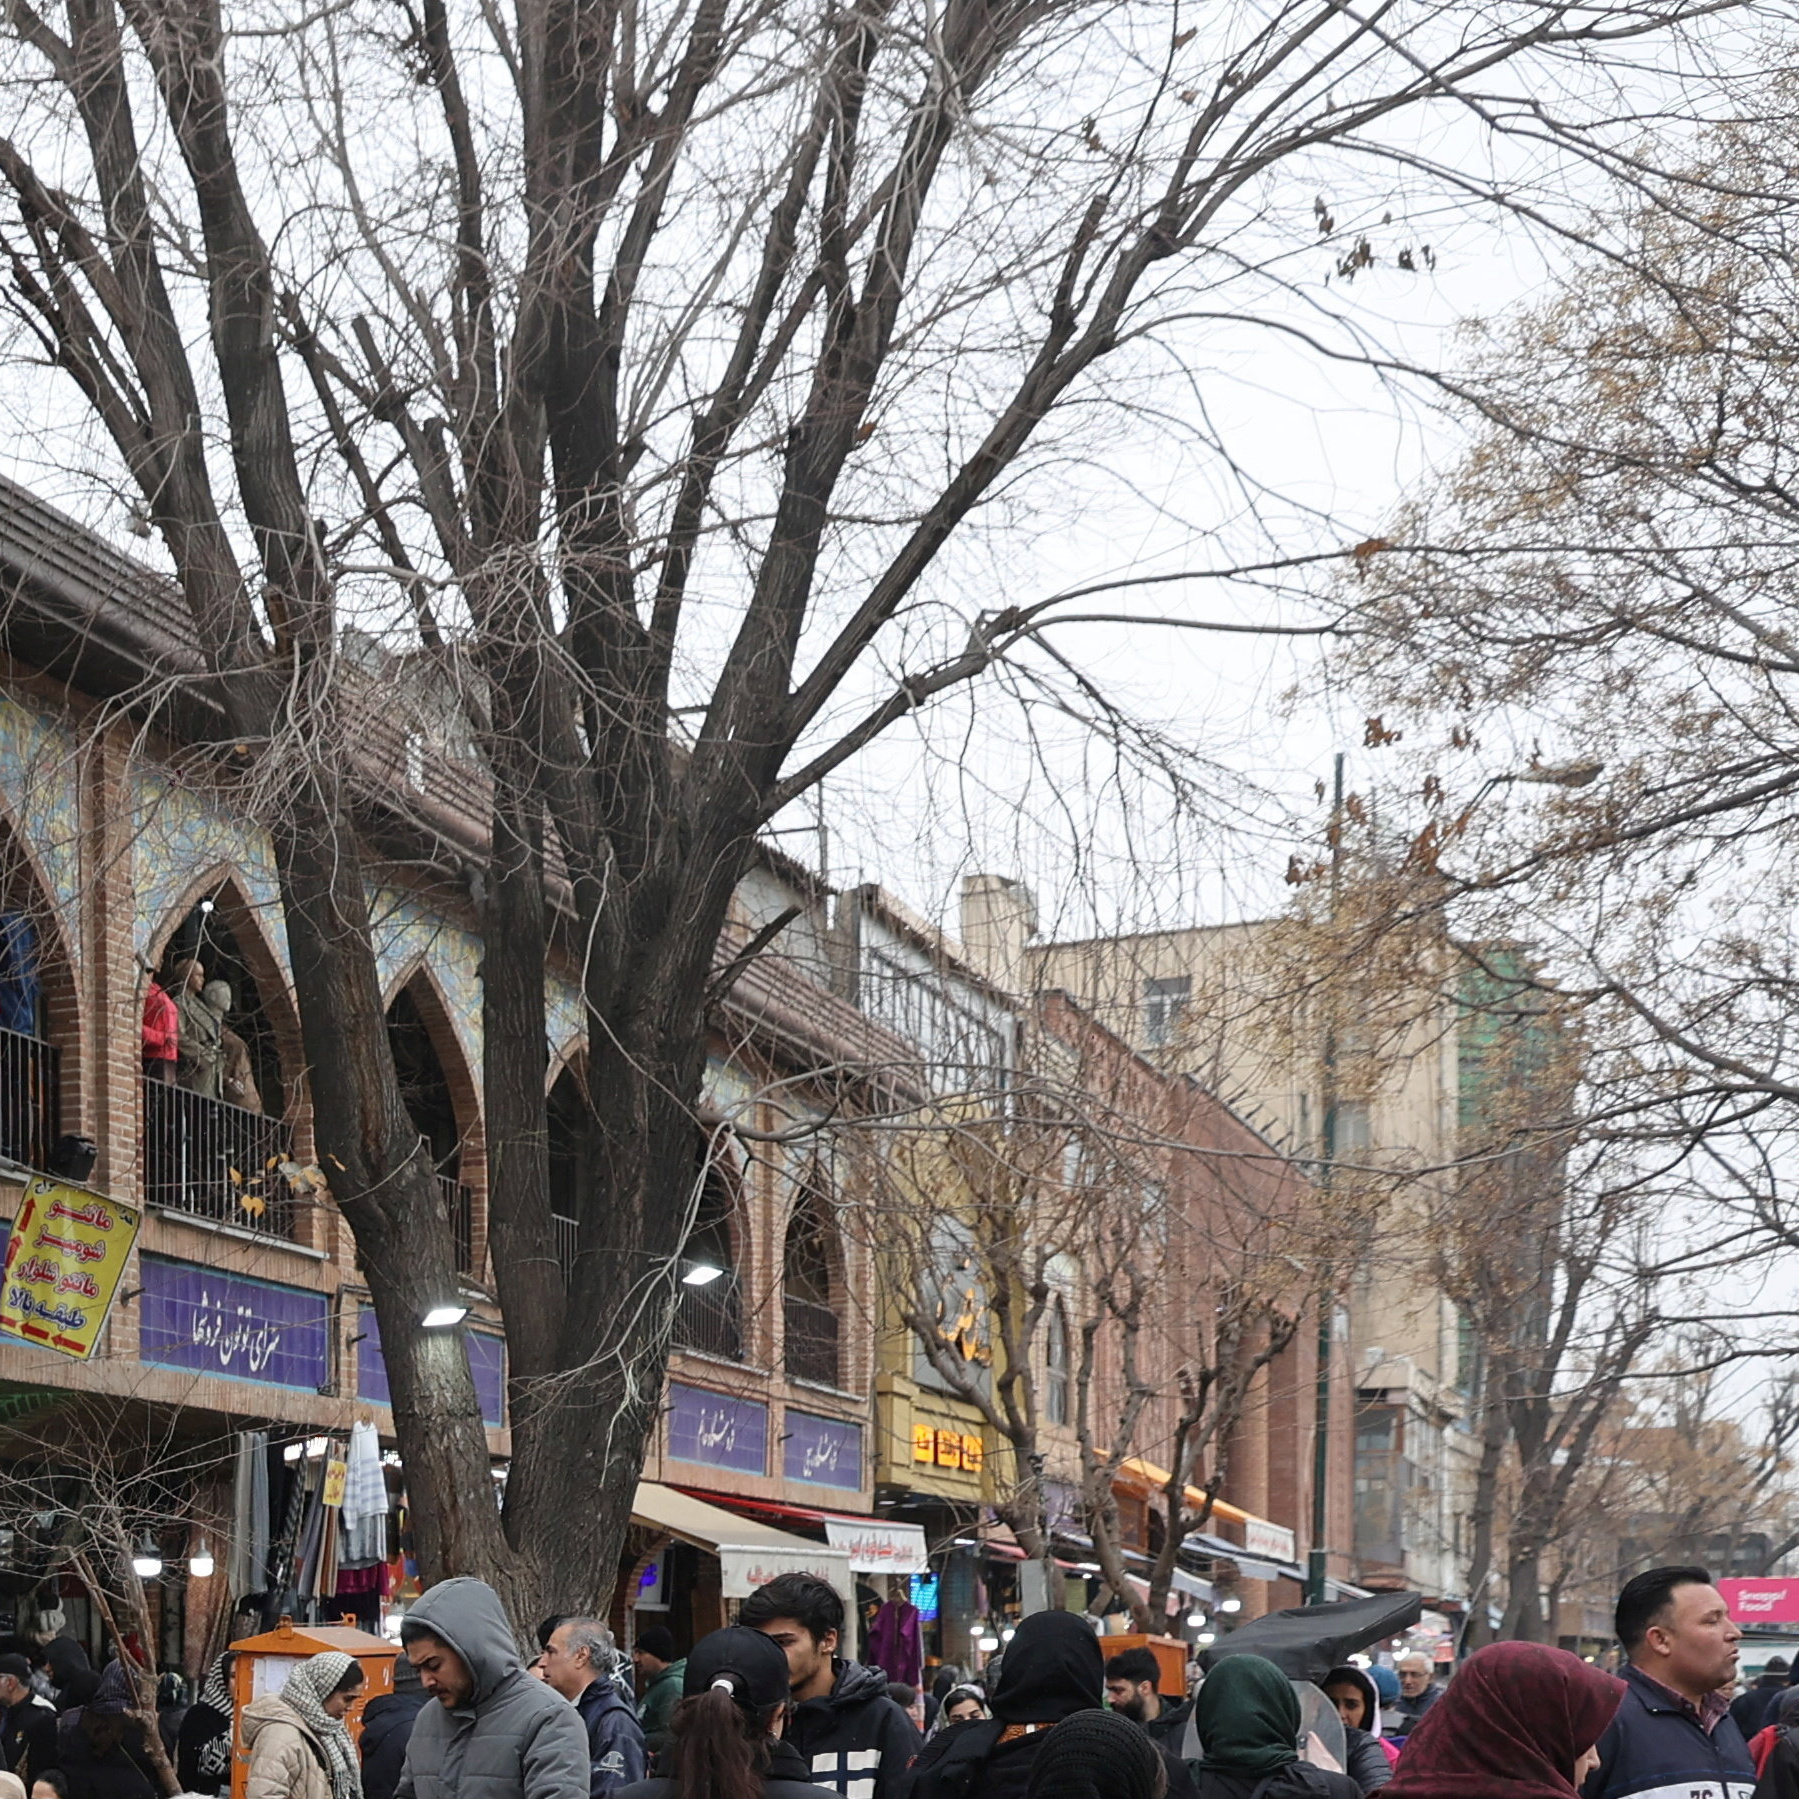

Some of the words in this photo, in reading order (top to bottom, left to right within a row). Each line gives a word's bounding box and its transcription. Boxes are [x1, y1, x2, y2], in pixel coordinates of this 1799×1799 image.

[44, 1199, 115, 1232] مانتو
[33, 1223, 107, 1264] شومیز
[12, 1256, 61, 1285] شلوار
[54, 1270, 101, 1299] مانتو
[8, 1286, 35, 1318] بالا
[35, 1300, 87, 1331] طبقه
[249, 1318, 280, 1372] سرای
[1738, 1600, 1776, 1613] Food
